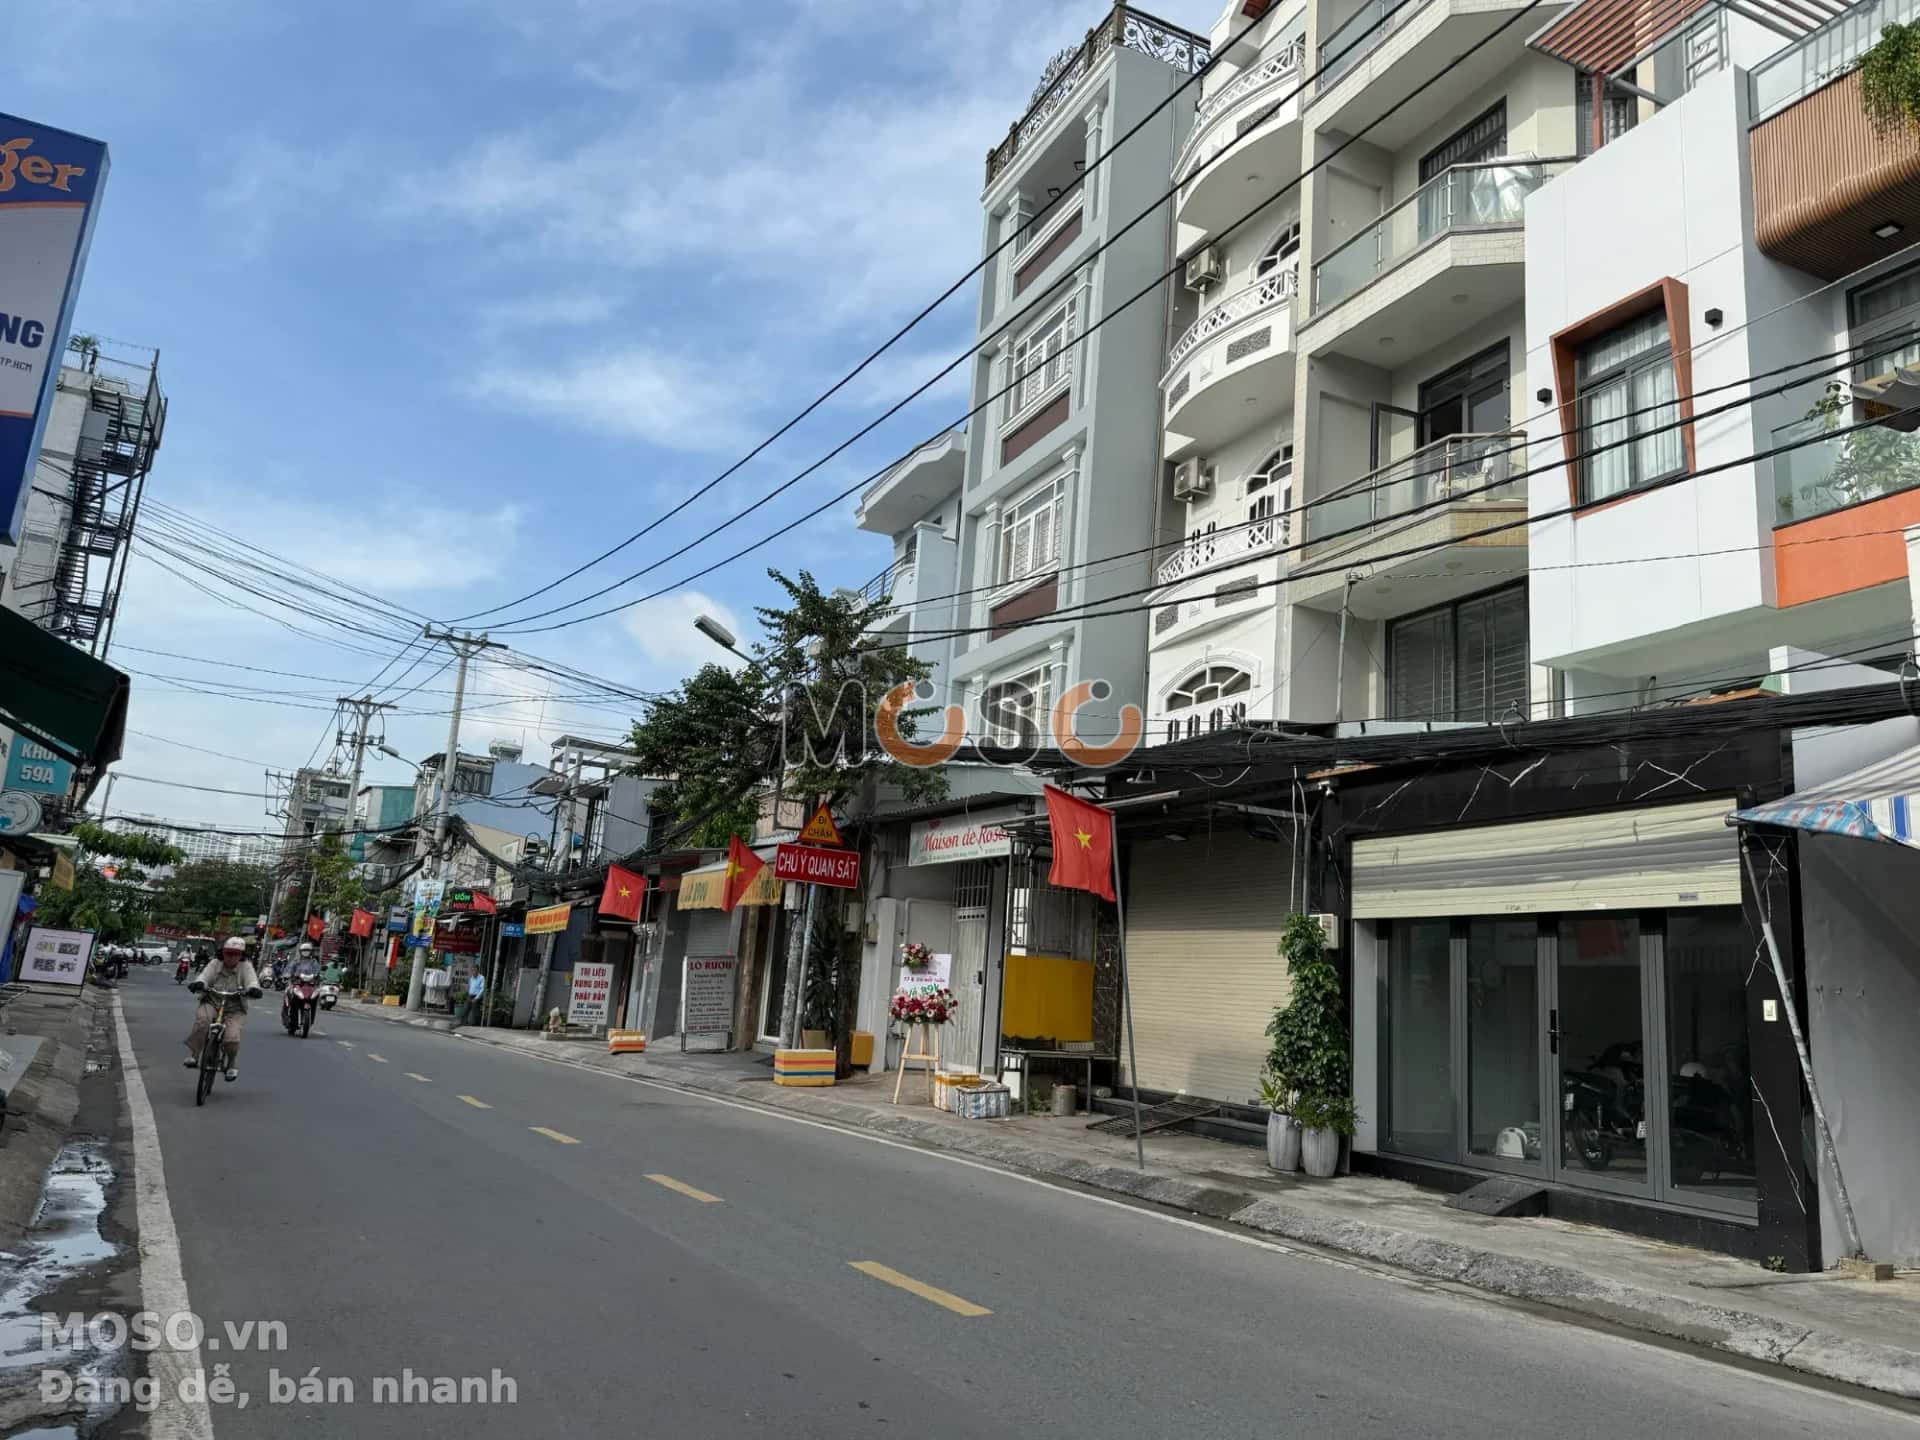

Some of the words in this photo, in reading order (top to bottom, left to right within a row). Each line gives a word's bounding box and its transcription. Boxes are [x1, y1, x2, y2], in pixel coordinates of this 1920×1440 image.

[0, 312, 44, 348] NG
[20, 764, 55, 784] 59A
[921, 832, 959, 851] Maison
[961, 828, 976, 846] de
[777, 850, 799, 873] CHÚ
[800, 850, 808, 875] Ý
[807, 855, 836, 877] QUAN
[836, 856, 857, 880] SÁT
